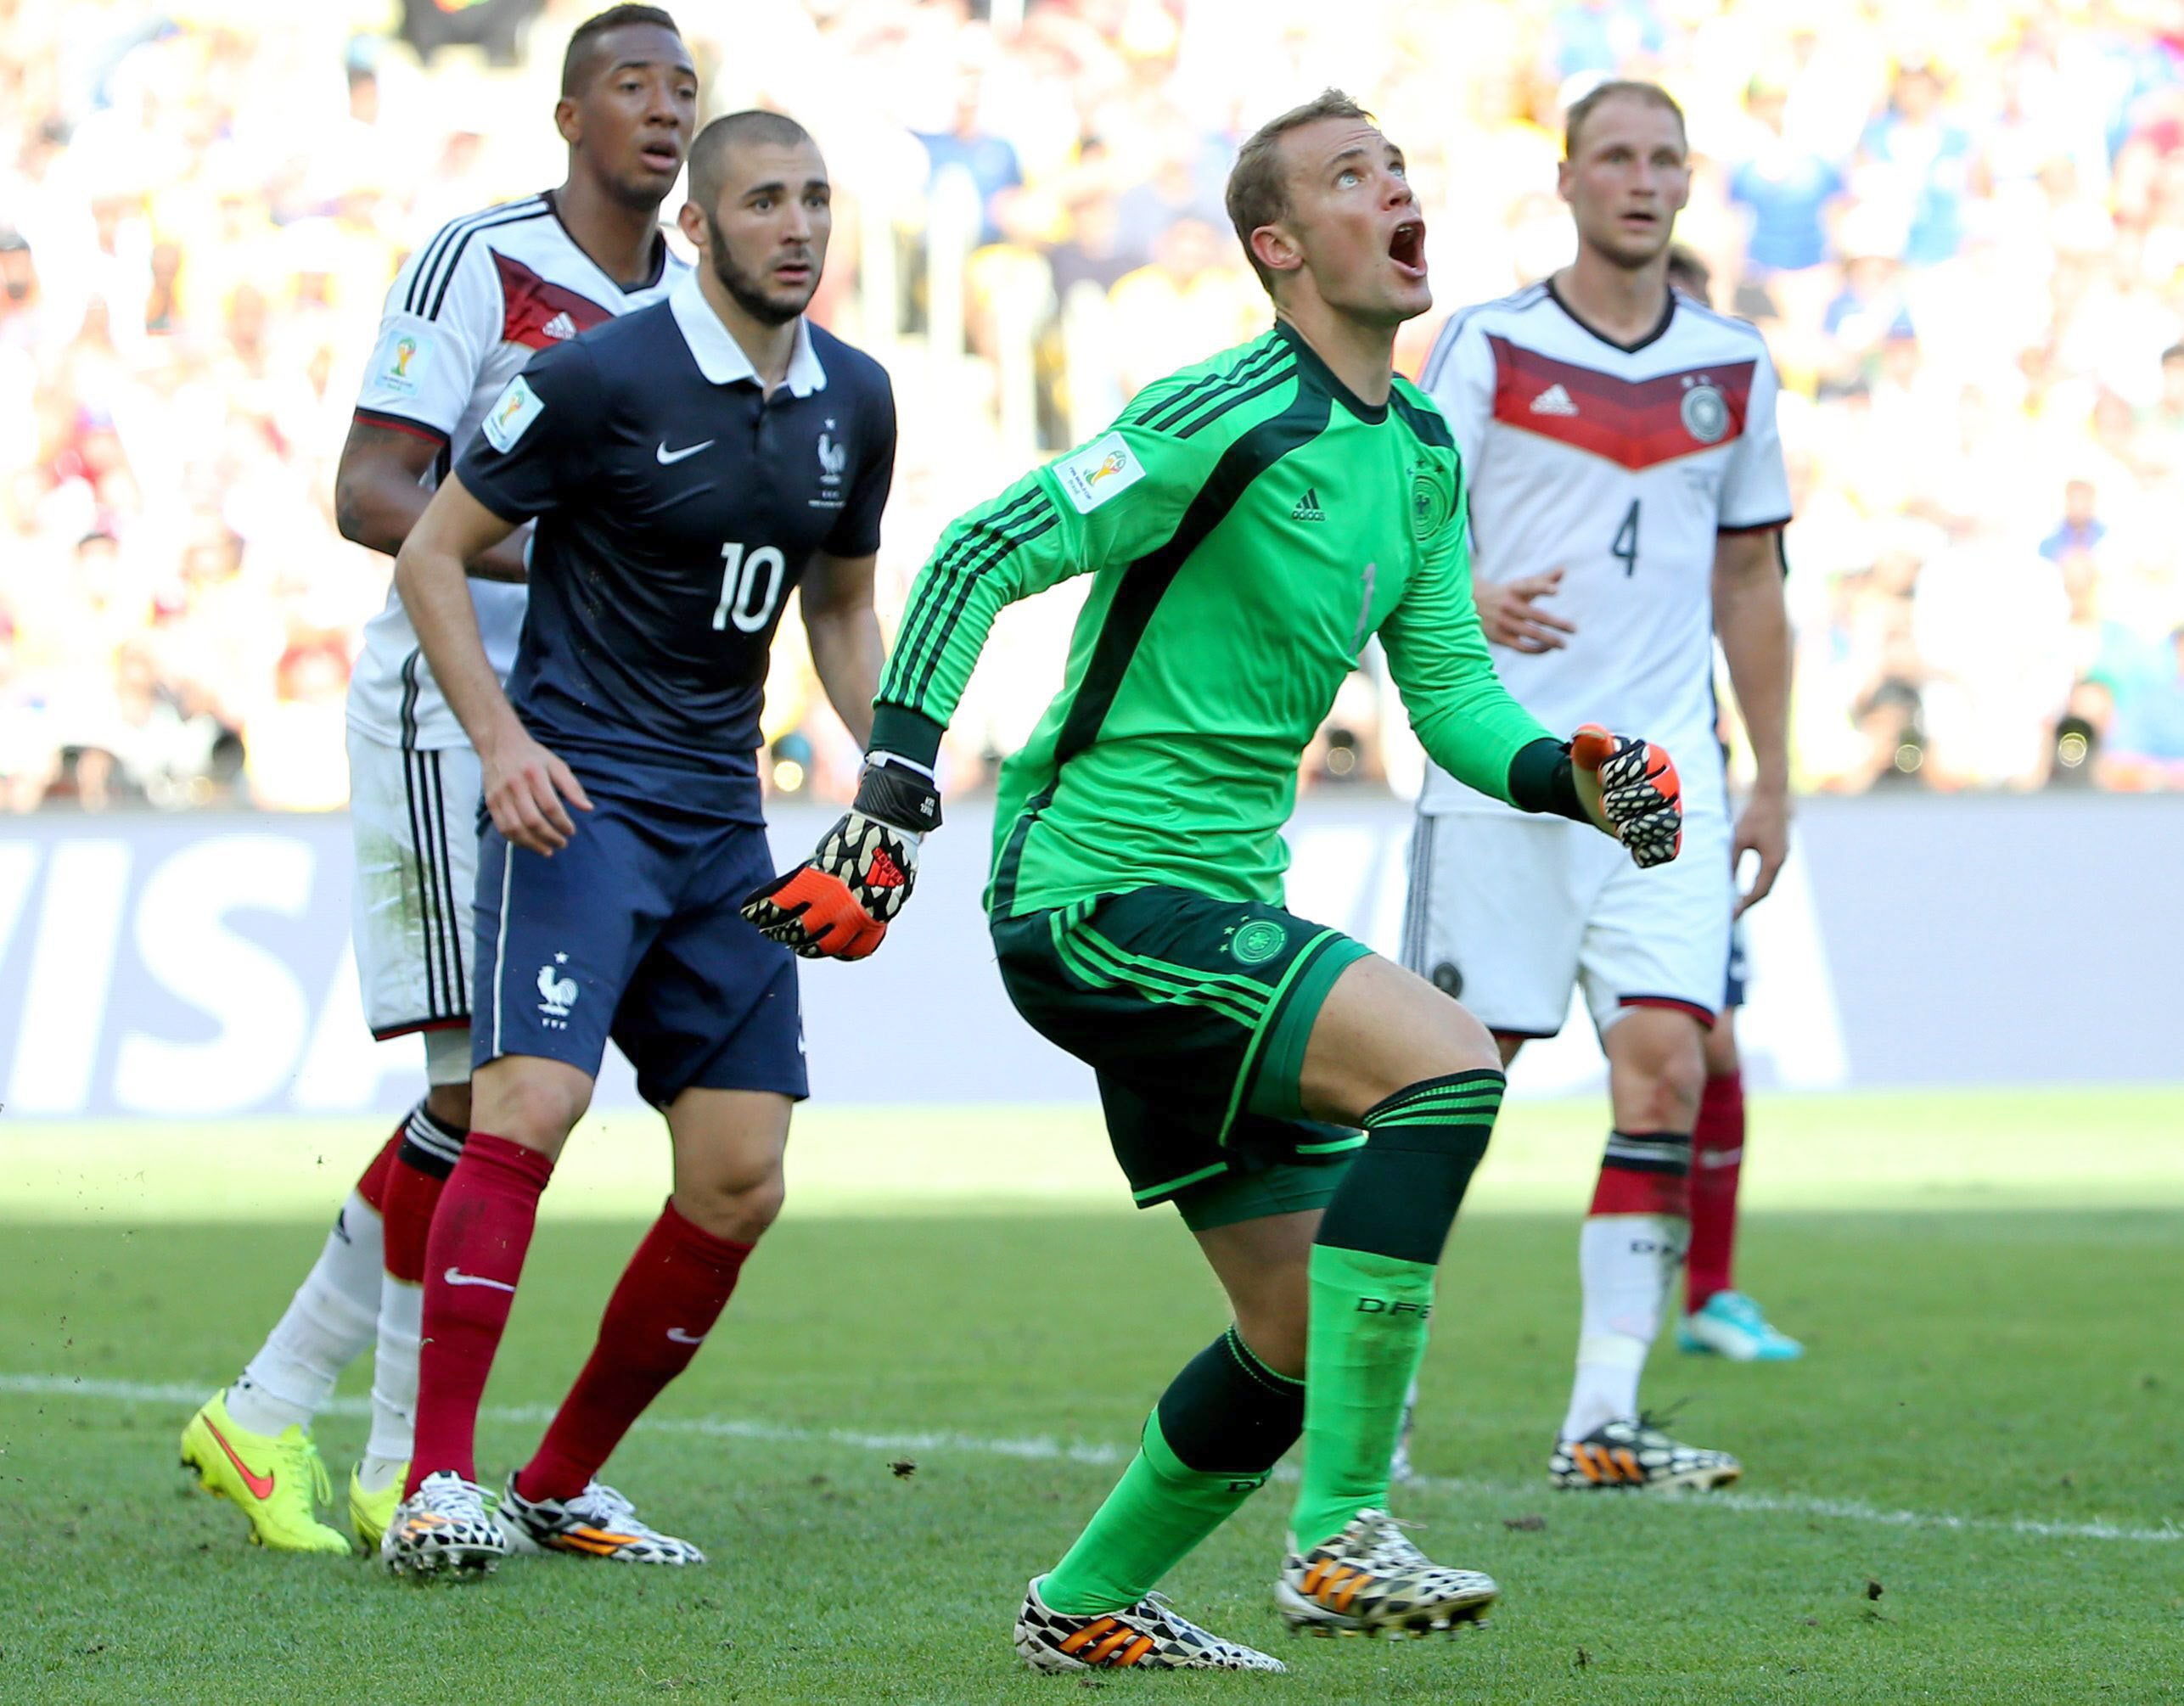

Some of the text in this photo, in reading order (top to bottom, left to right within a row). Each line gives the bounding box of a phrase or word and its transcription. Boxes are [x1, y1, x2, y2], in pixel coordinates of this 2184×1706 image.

[1291, 510, 1326, 522] adidas
[1611, 498, 1641, 578] 4
[713, 542, 785, 632] 10
